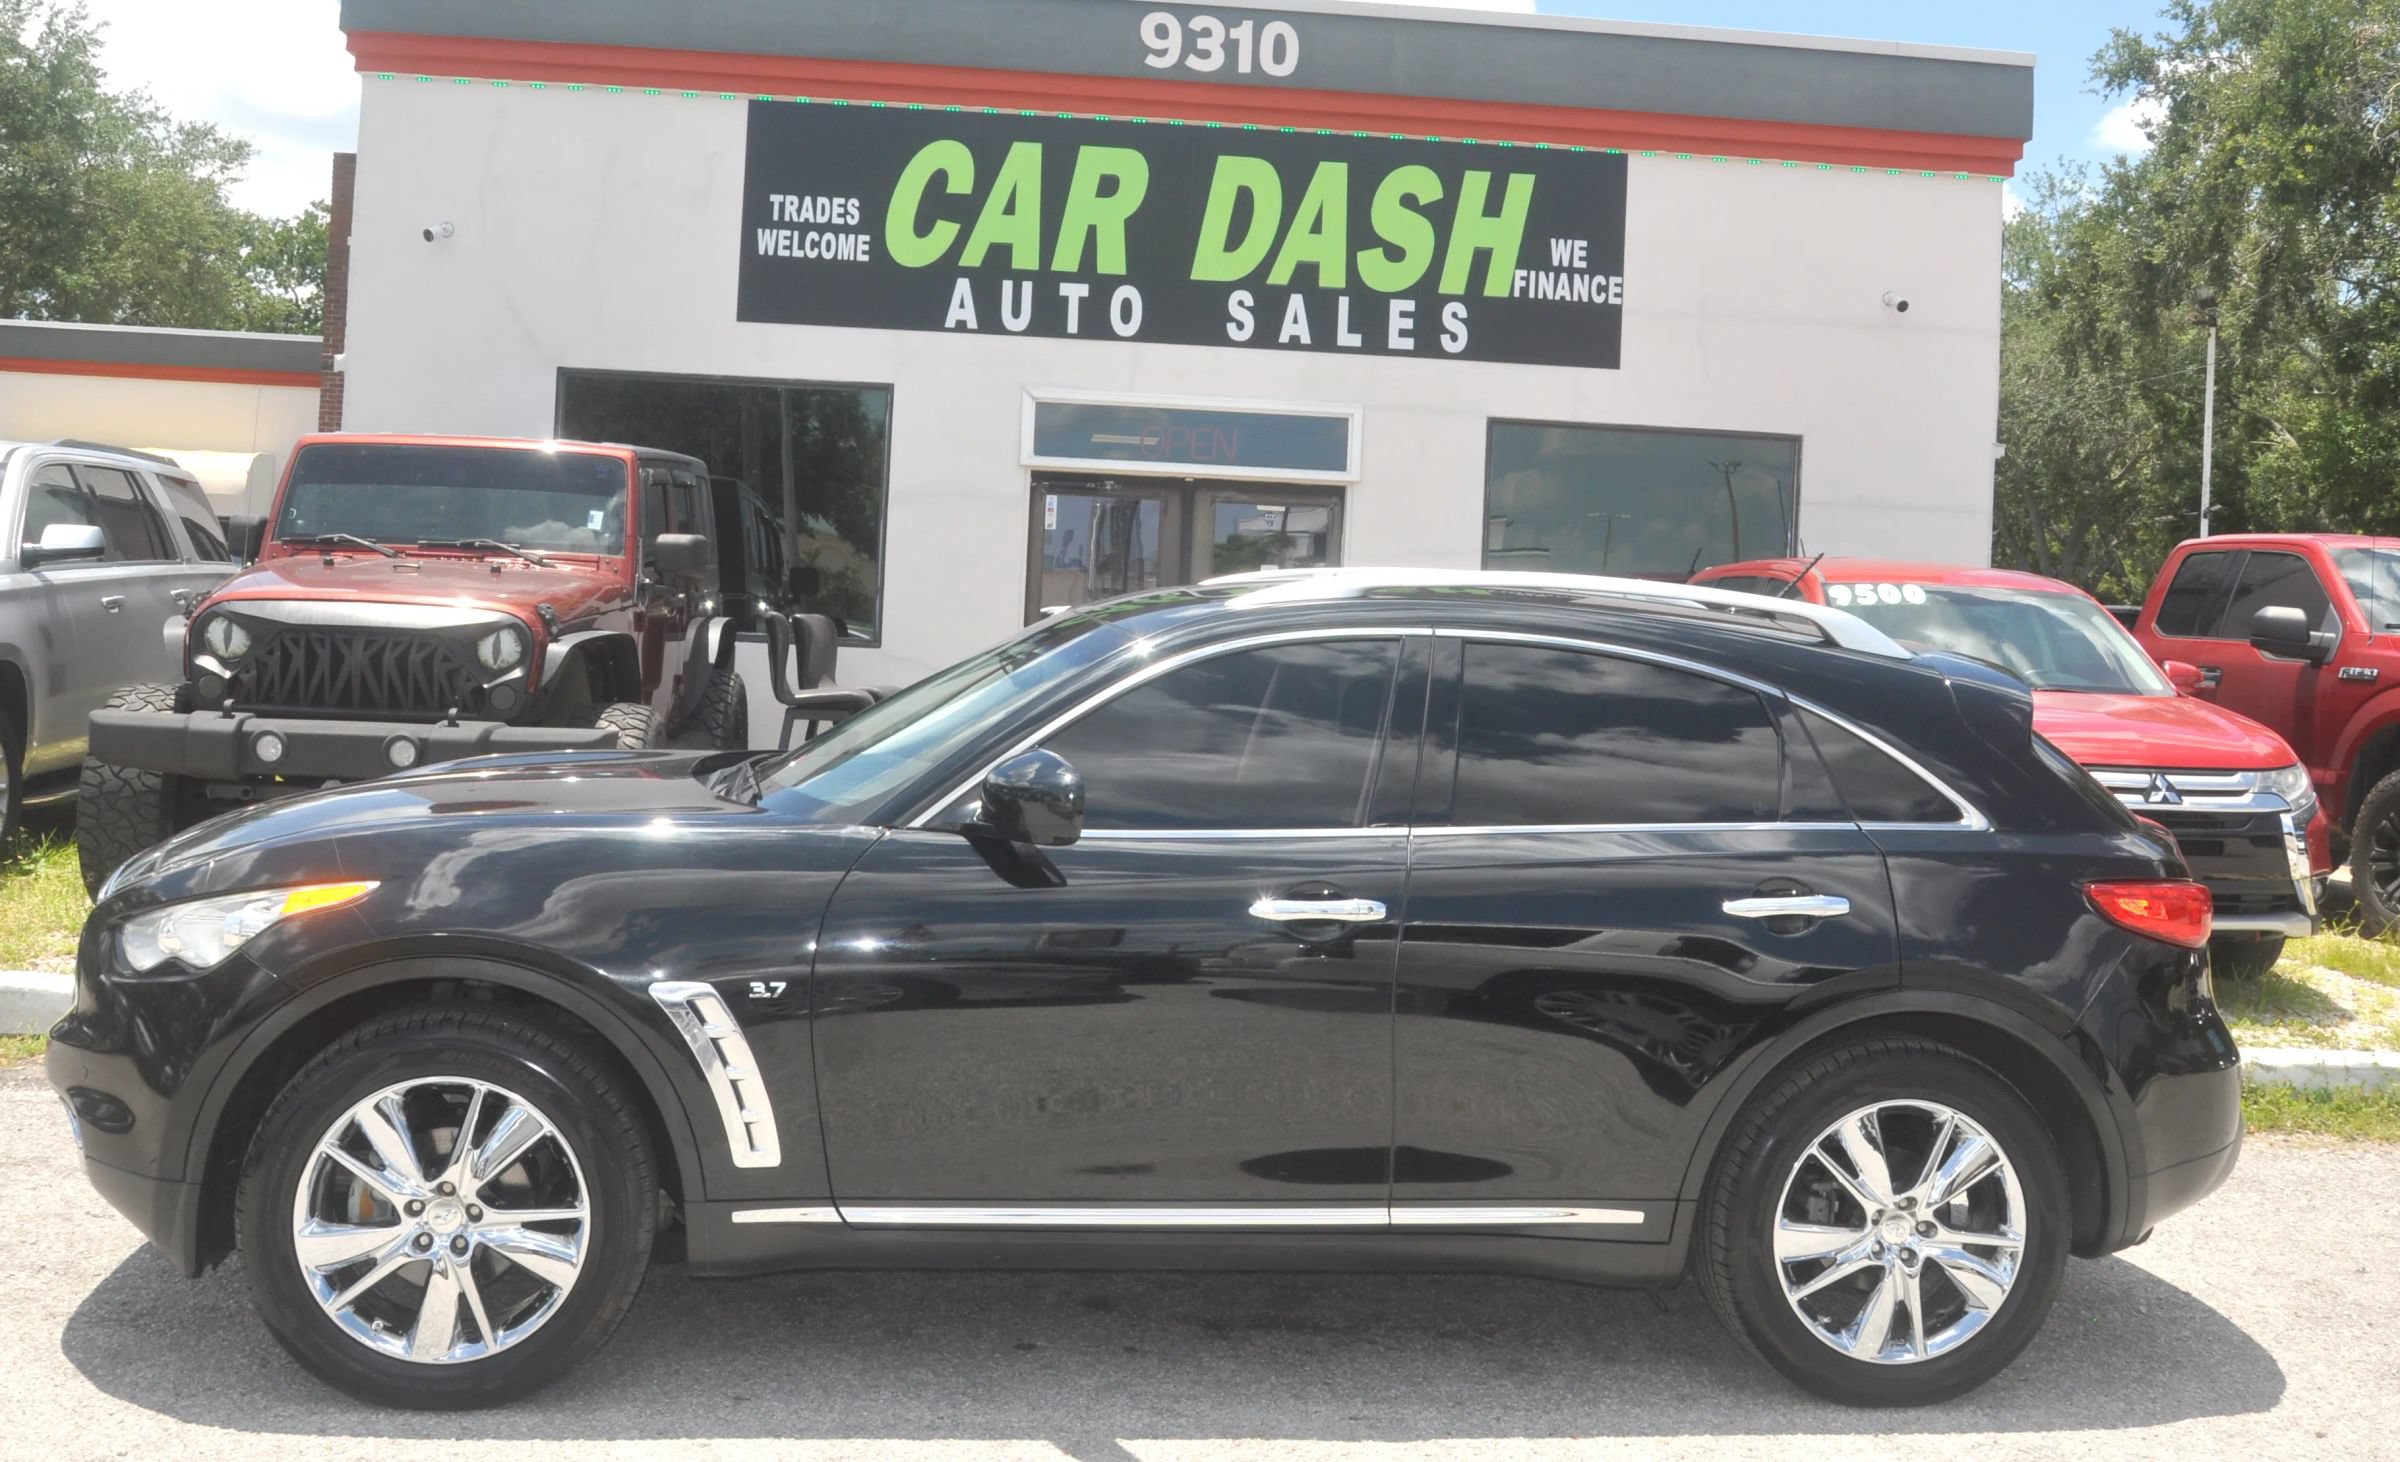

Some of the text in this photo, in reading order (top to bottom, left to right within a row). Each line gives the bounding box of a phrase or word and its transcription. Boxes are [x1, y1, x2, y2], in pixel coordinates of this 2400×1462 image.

[1140, 11, 1300, 77] 9310
[769, 194, 860, 225] TRADES
[885, 140, 1535, 298] CAR DASH
[757, 228, 870, 262] WELCOME
[1550, 238, 1588, 269] WE
[1513, 269, 1623, 305] FINANCE
[944, 277, 1470, 354] AUTO SALES
[1142, 425, 1238, 464] OPEN
[1828, 583, 1926, 606] 9500
